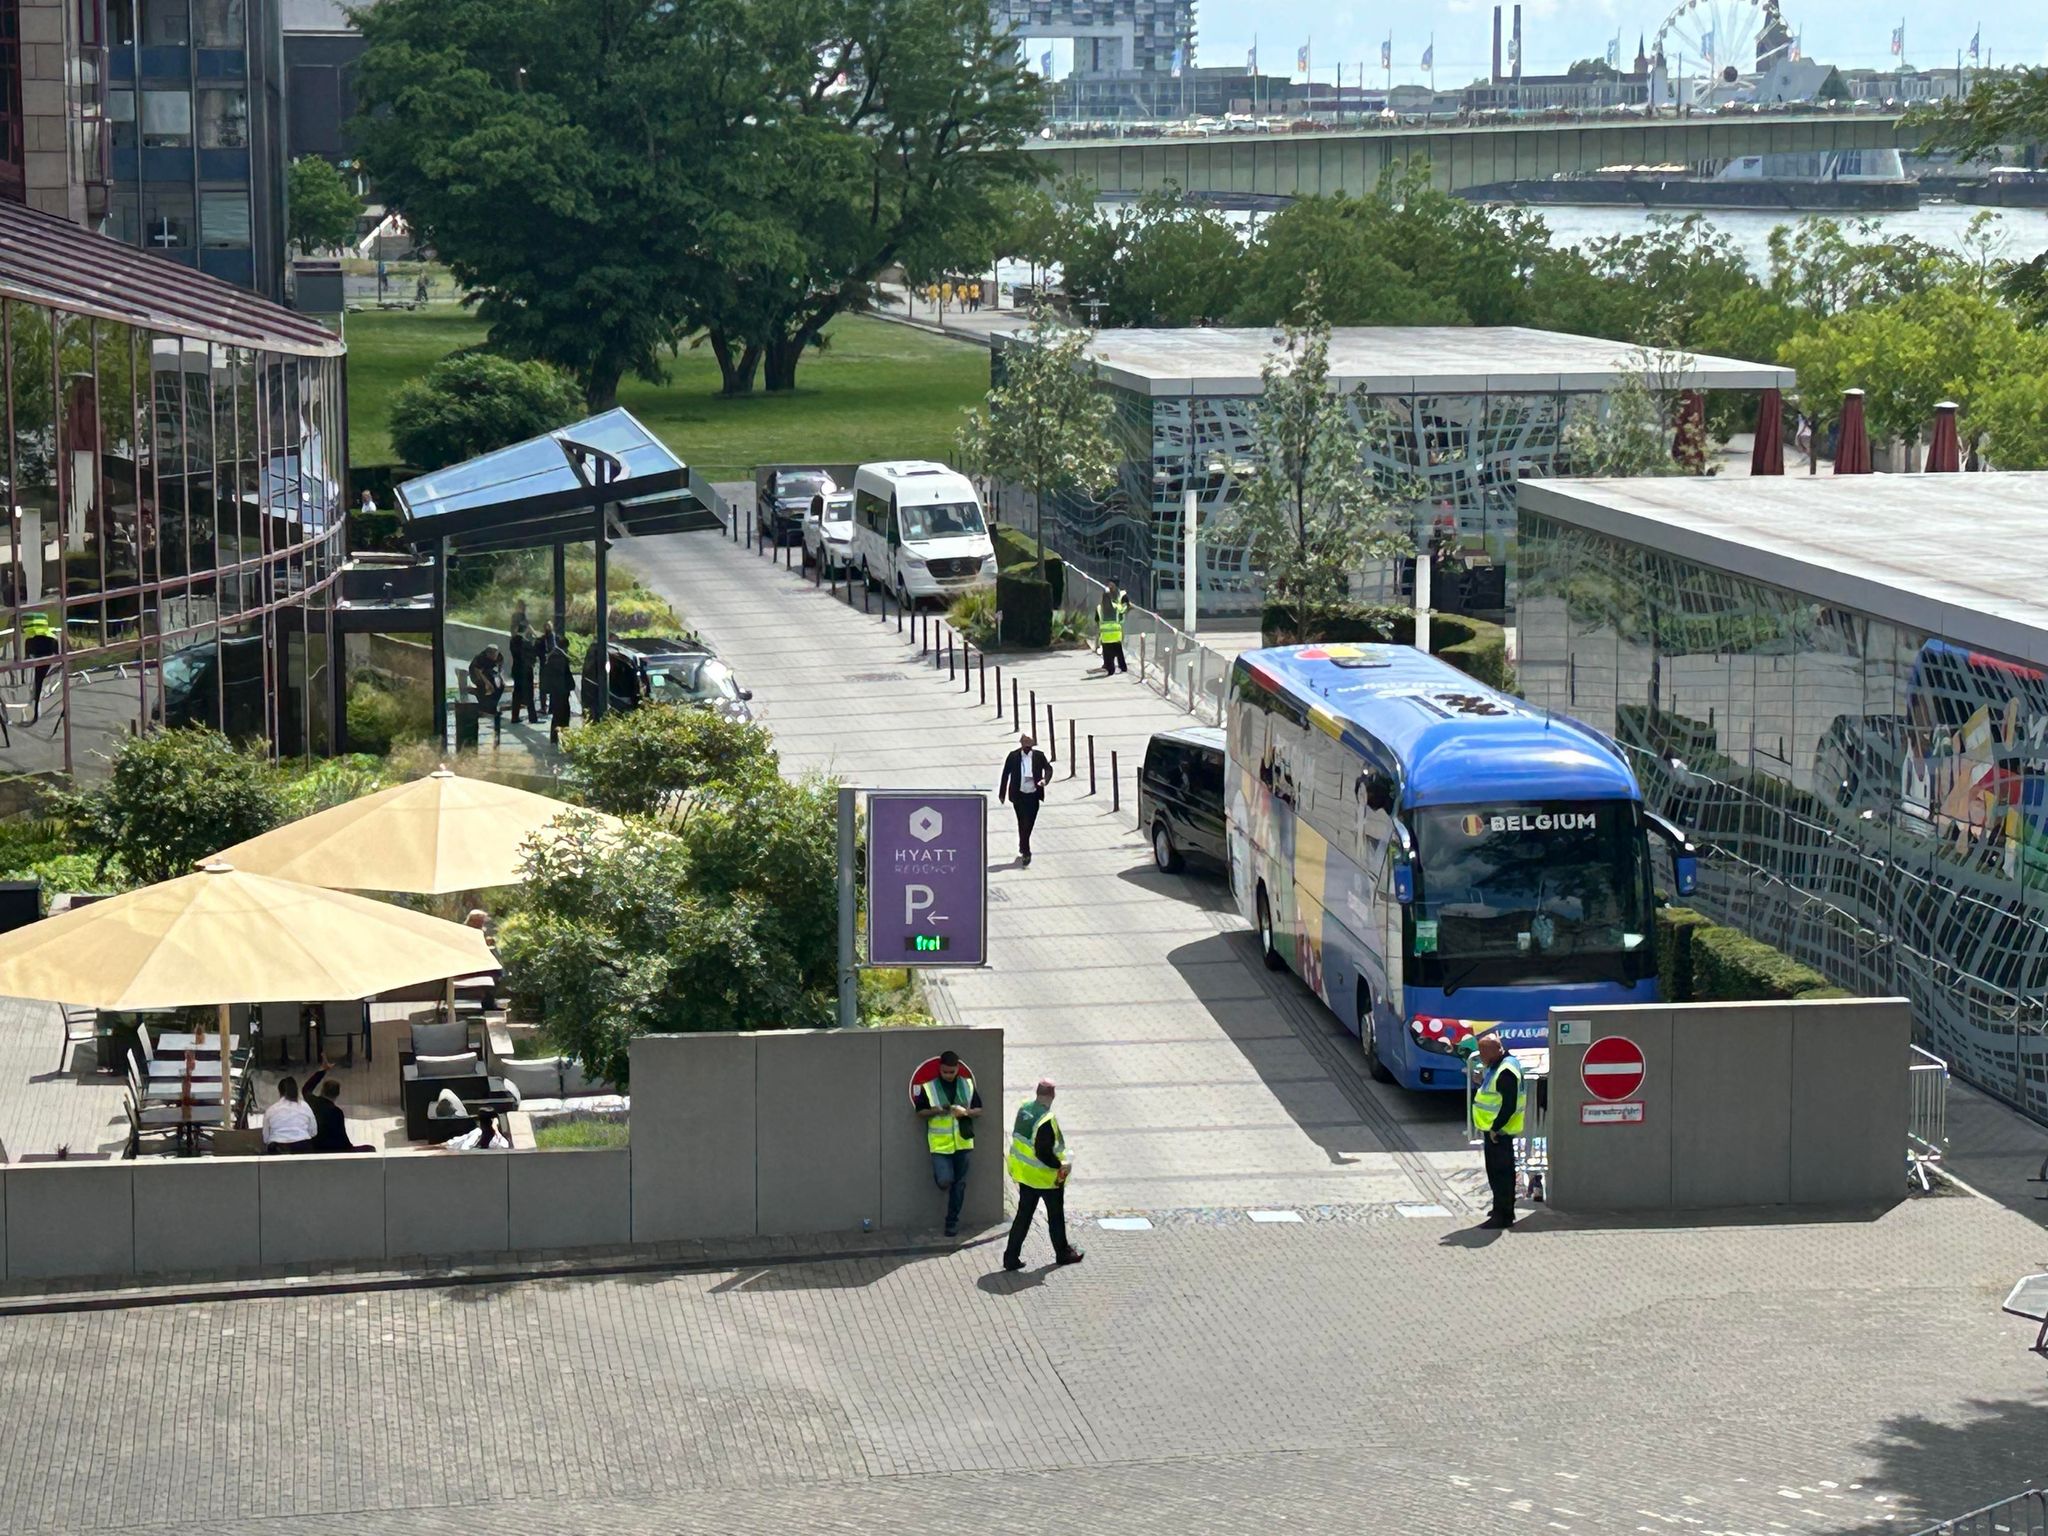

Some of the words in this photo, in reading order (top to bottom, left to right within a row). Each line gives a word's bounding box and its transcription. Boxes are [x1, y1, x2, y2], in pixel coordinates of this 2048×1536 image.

[1490, 813, 1597, 832] BELGIUM
[895, 849, 957, 861] HYATT
[905, 884, 934, 925] P
